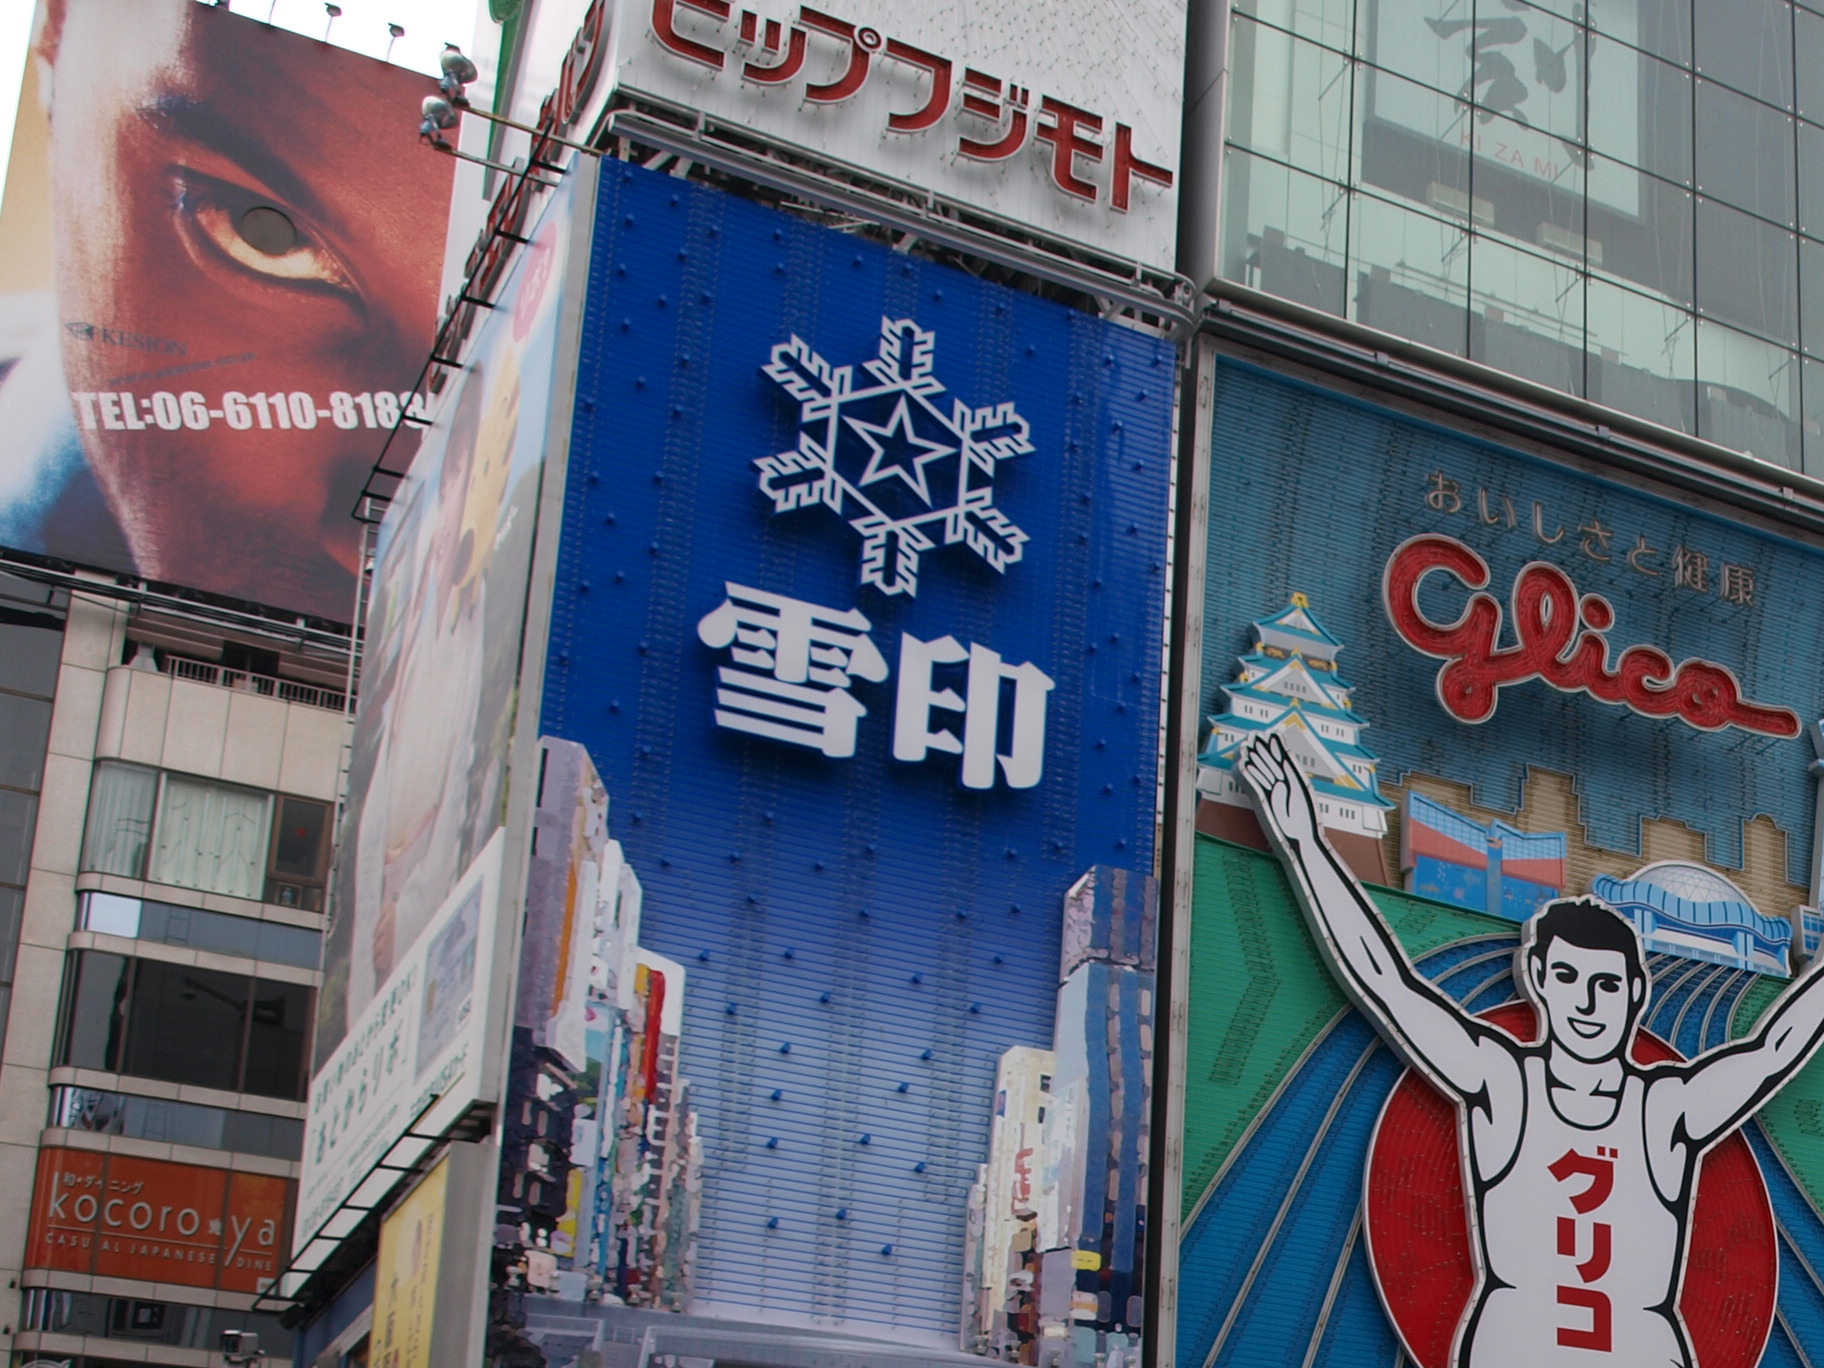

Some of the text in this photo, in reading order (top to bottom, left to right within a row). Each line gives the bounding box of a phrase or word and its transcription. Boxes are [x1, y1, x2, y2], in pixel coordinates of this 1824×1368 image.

[1493, 141, 1526, 169] ZA
[100, 327, 190, 357] KESION
[1426, 470, 1757, 608] おいしさと健康
[697, 581, 1055, 790] 雪印
[1382, 533, 1802, 740] Glico
[45, 1232, 273, 1272] CASUAL JAPANESE DINE
[48, 1172, 200, 1237] kocoro
[1546, 1145, 1619, 1353] グリコ
